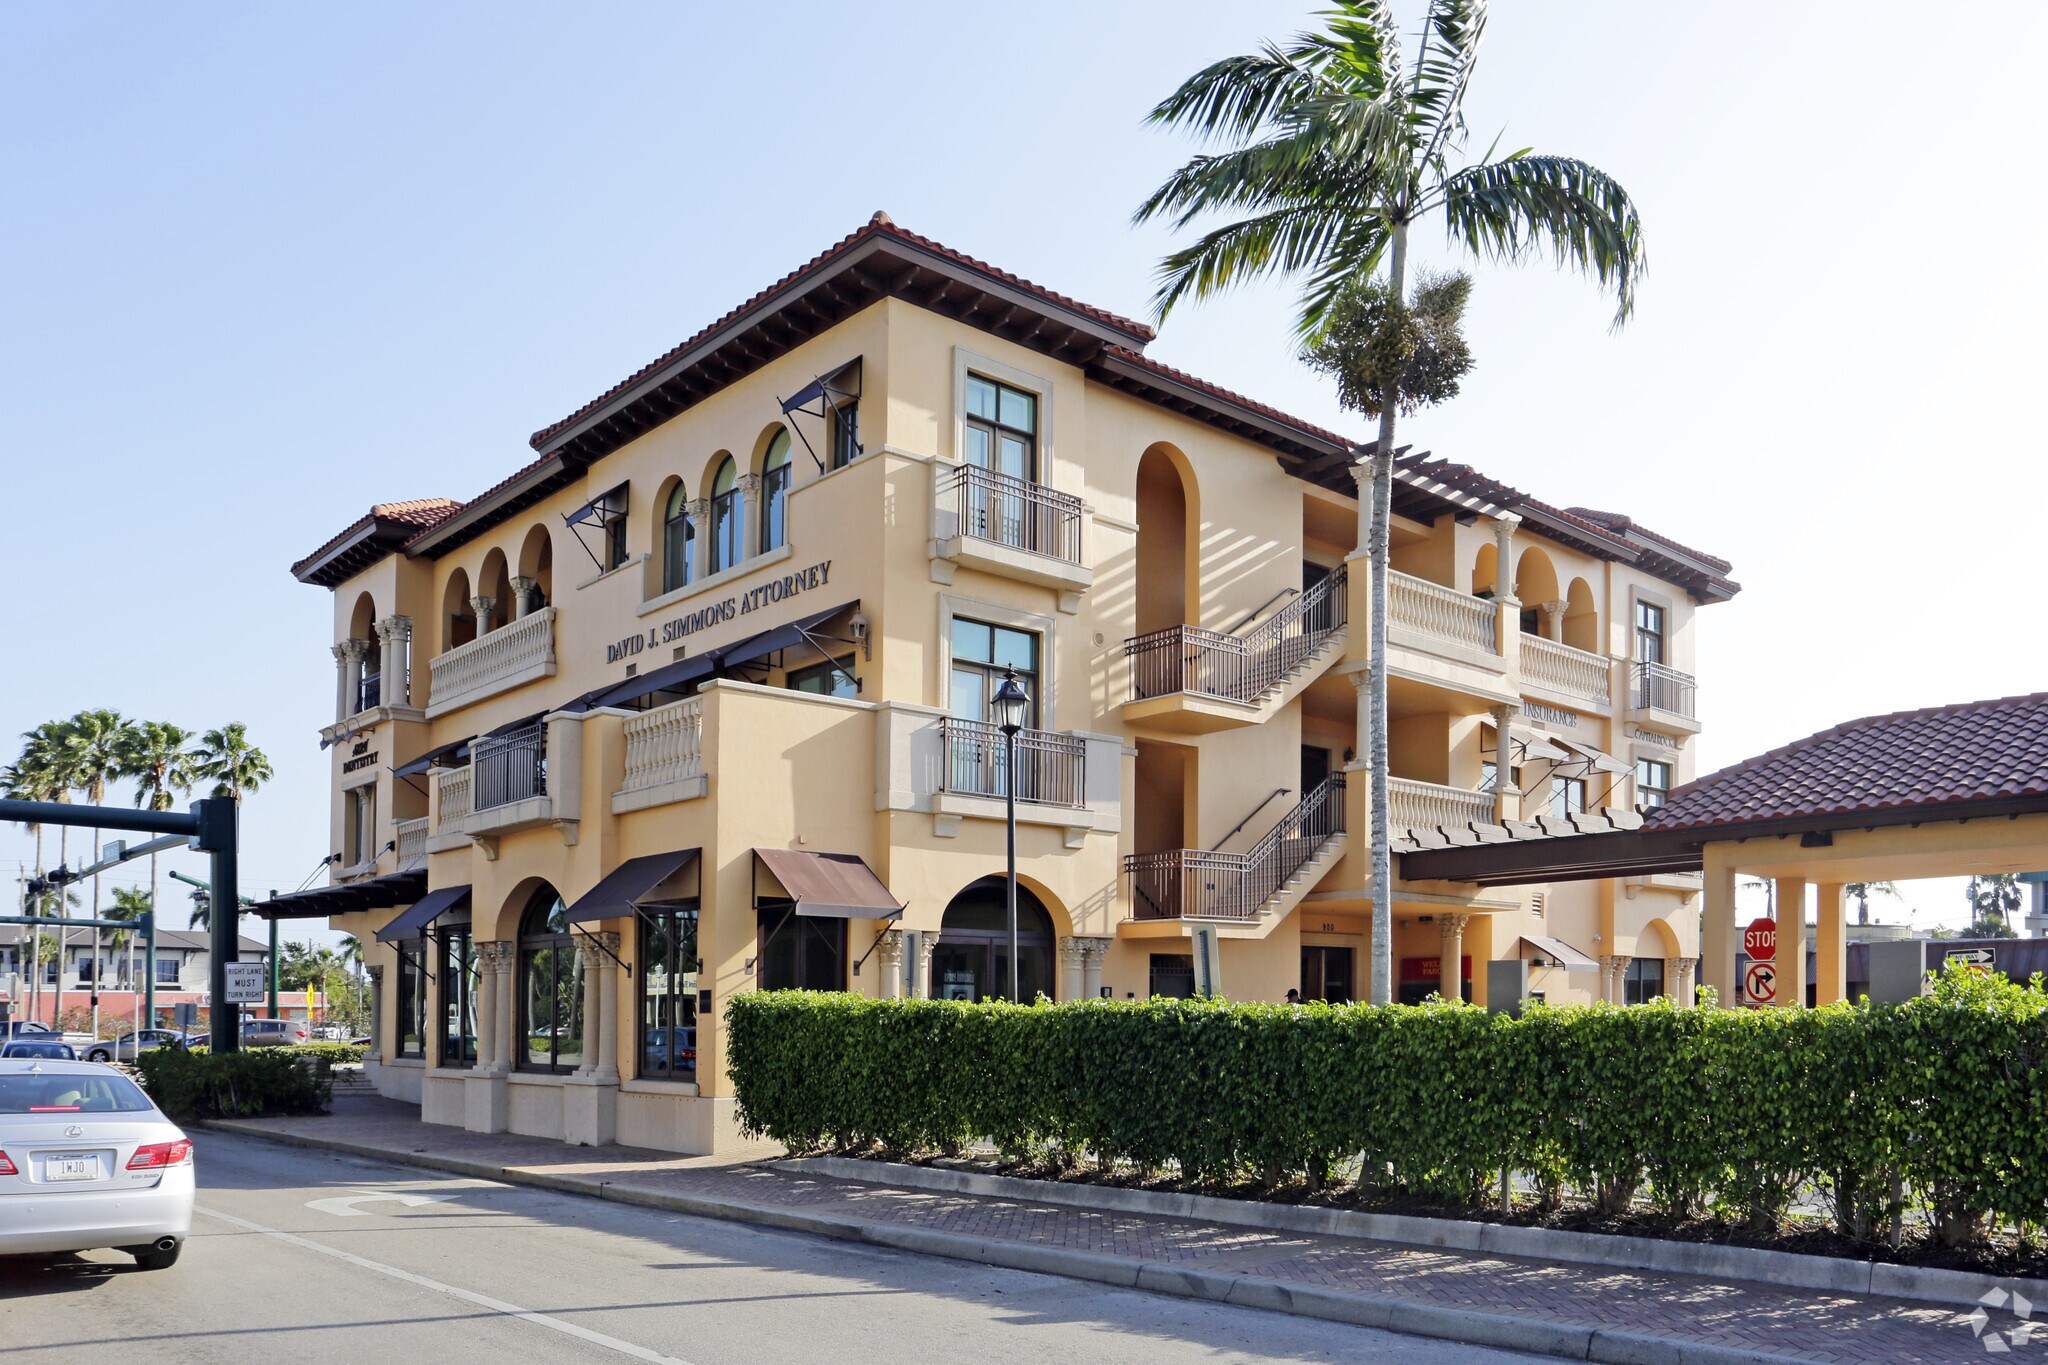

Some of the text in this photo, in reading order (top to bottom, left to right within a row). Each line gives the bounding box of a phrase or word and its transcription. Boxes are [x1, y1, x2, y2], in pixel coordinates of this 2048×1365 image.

[606, 560, 832, 664] DAVID J. SIMMONS ATTORNEY
[1524, 701, 1577, 728] INSURANCE
[1422, 960, 1441, 968] WEL
[235, 979, 256, 987] MUST
